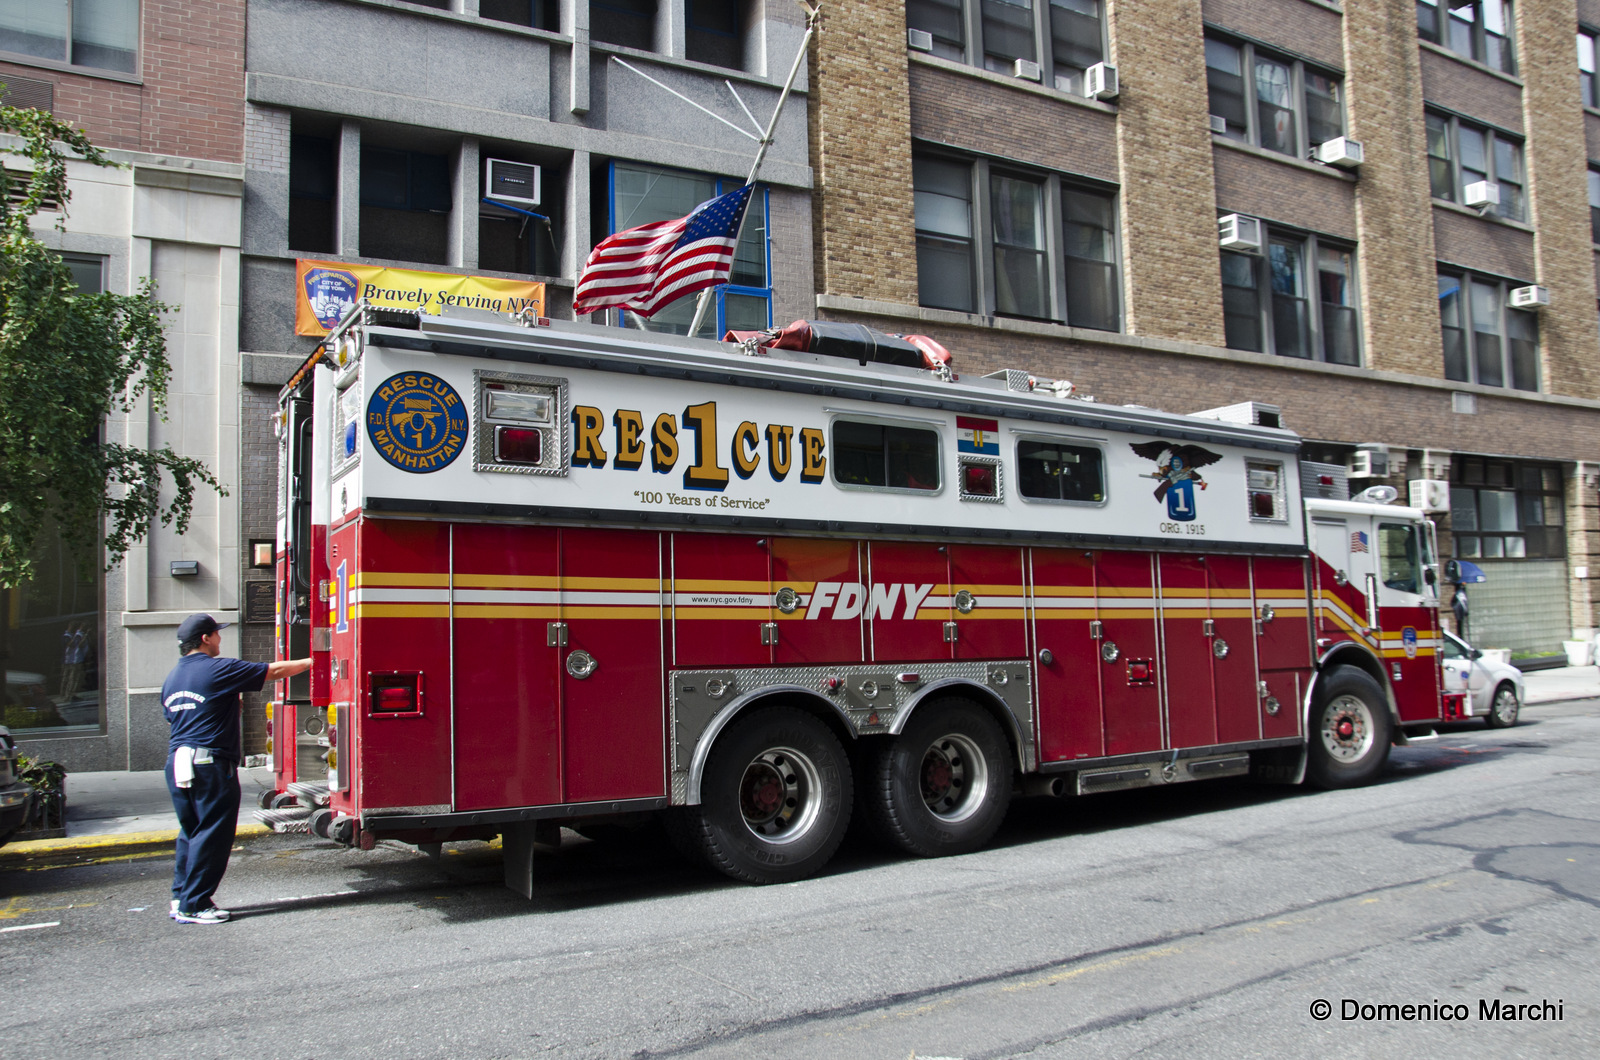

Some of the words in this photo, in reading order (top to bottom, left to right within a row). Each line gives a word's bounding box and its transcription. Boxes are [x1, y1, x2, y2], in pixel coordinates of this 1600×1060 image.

[307, 274, 320, 286] FIRE
[319, 271, 356, 288] DEPARTMENT
[363, 283, 433, 306] Bravely
[436, 291, 502, 312] Serving
[506, 297, 540, 313] NYC
[378, 375, 459, 408] RESCUE
[369, 412, 385, 425] F.D.
[451, 418, 466, 431] N.Y.
[374, 429, 462, 468] MANHATTAN
[411, 432, 422, 448] 1
[667, 492, 701, 507] Years
[705, 495, 717, 507] of
[1174, 487, 1189, 512] 1
[1159, 522, 1183, 534] ORG.
[1185, 524, 1205, 535] 1915
[336, 558, 349, 634] 1
[691, 595, 754, 605] www.nyc.gov.fdny
[805, 582, 934, 621] FDNY
